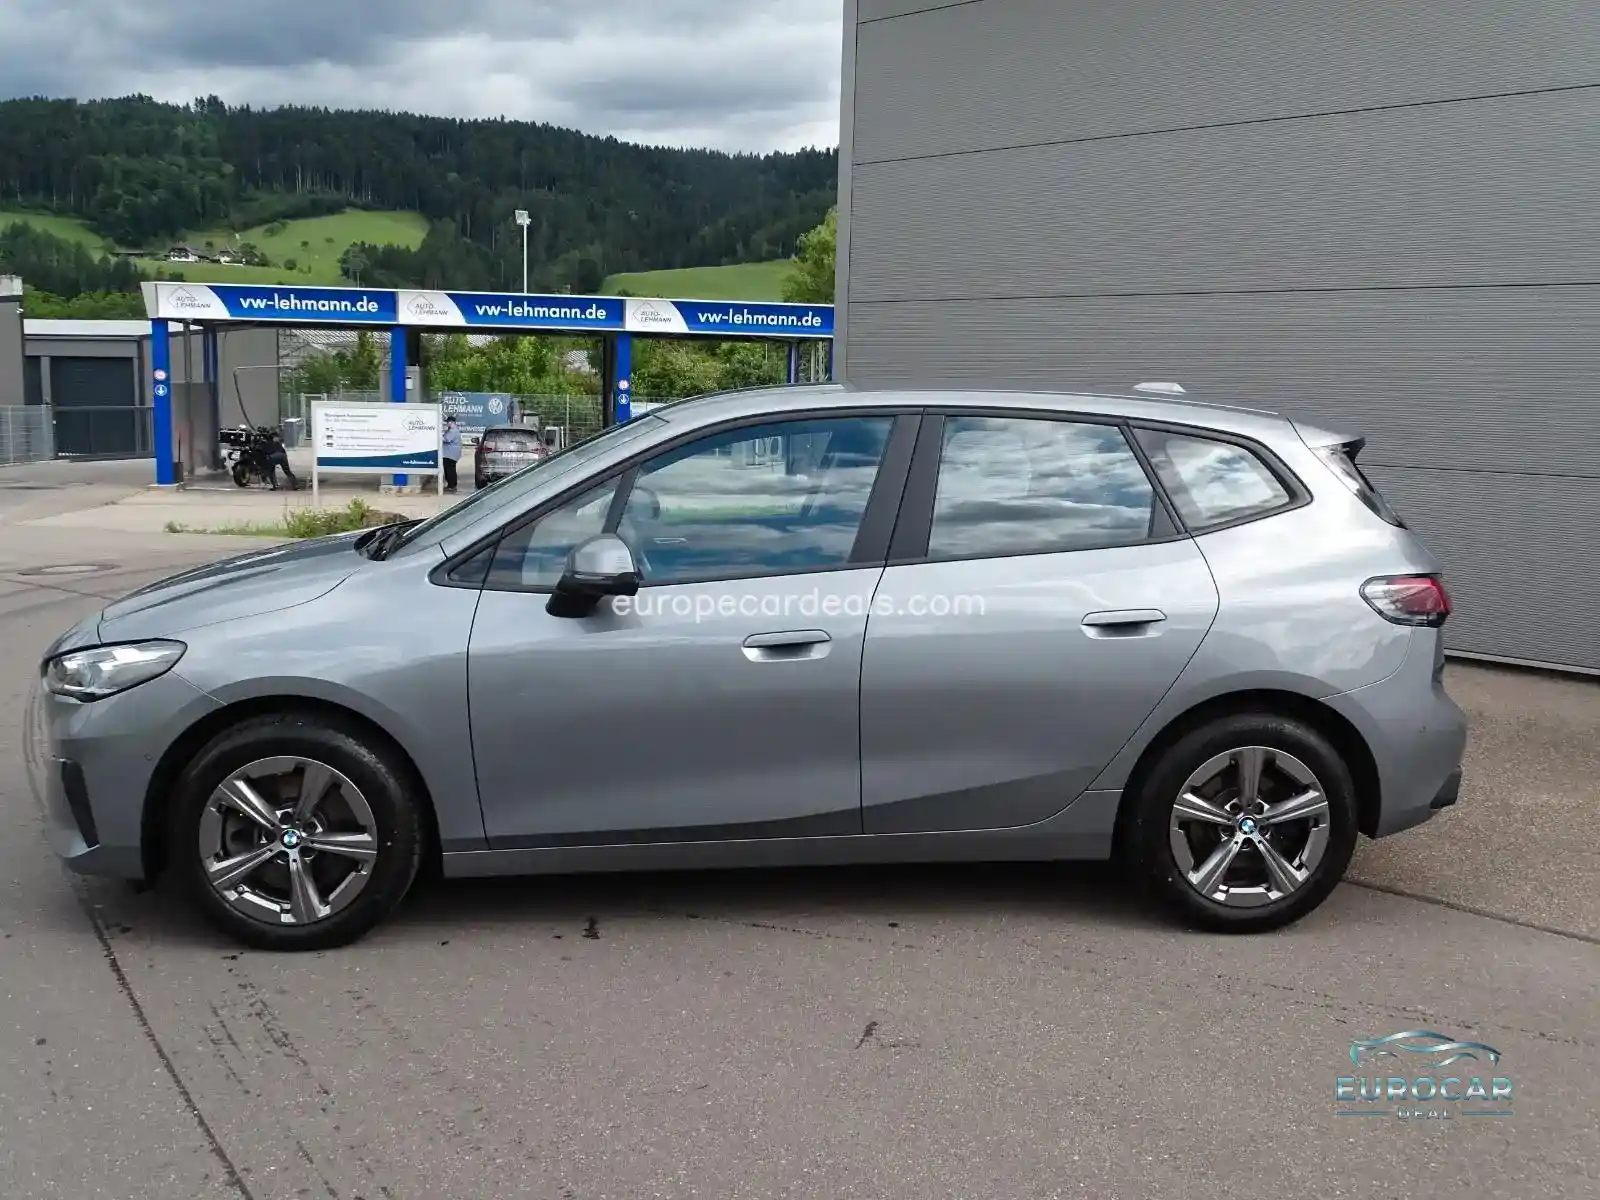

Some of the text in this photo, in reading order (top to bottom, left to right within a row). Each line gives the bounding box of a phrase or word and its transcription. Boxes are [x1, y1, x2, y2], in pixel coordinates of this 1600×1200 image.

[176, 301, 211, 309] LEHMANN
[240, 293, 379, 313] vw-lehmann.de
[415, 308, 448, 316] LEHMANN
[475, 301, 607, 319] vw-lehmann.de
[697, 308, 822, 327] vw-lehmann.de
[443, 396, 469, 405] AUTO-
[443, 404, 484, 413] LEHMANN
